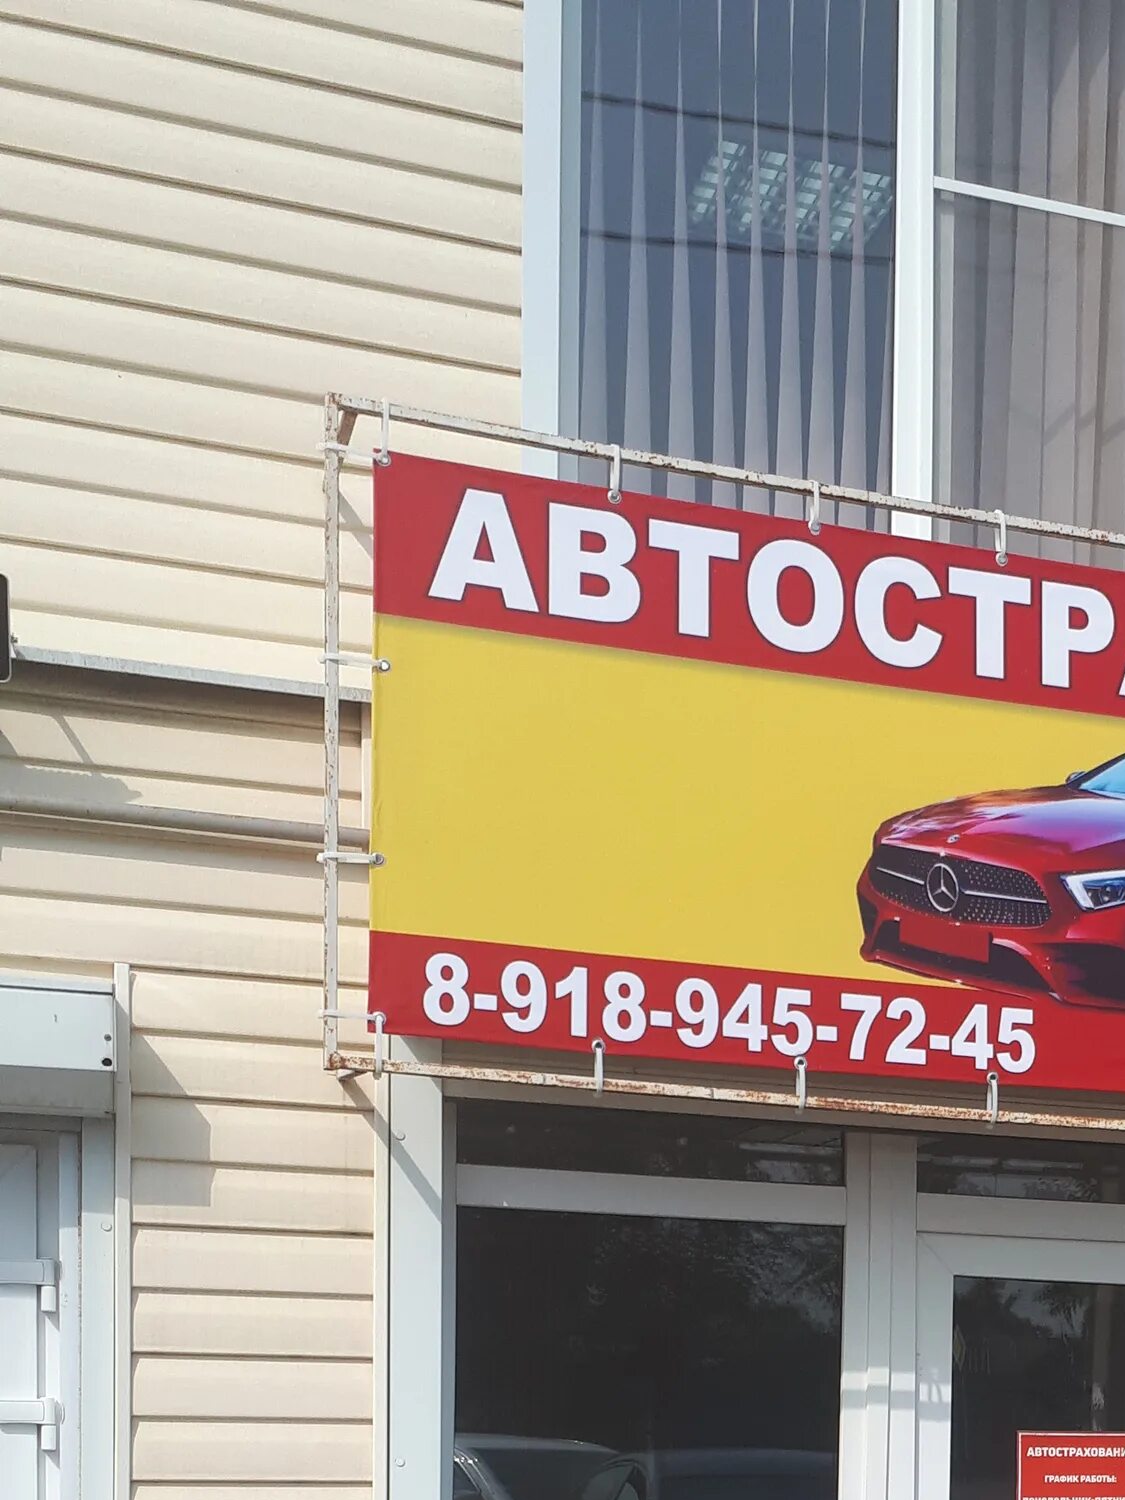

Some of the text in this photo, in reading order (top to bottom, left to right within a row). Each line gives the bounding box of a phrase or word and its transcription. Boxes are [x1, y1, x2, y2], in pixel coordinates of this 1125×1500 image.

[422, 952, 1036, 1074] 8-918-945-72-45
[1044, 1475, 1117, 1483] ГРАФИК РАБОТЫ:
